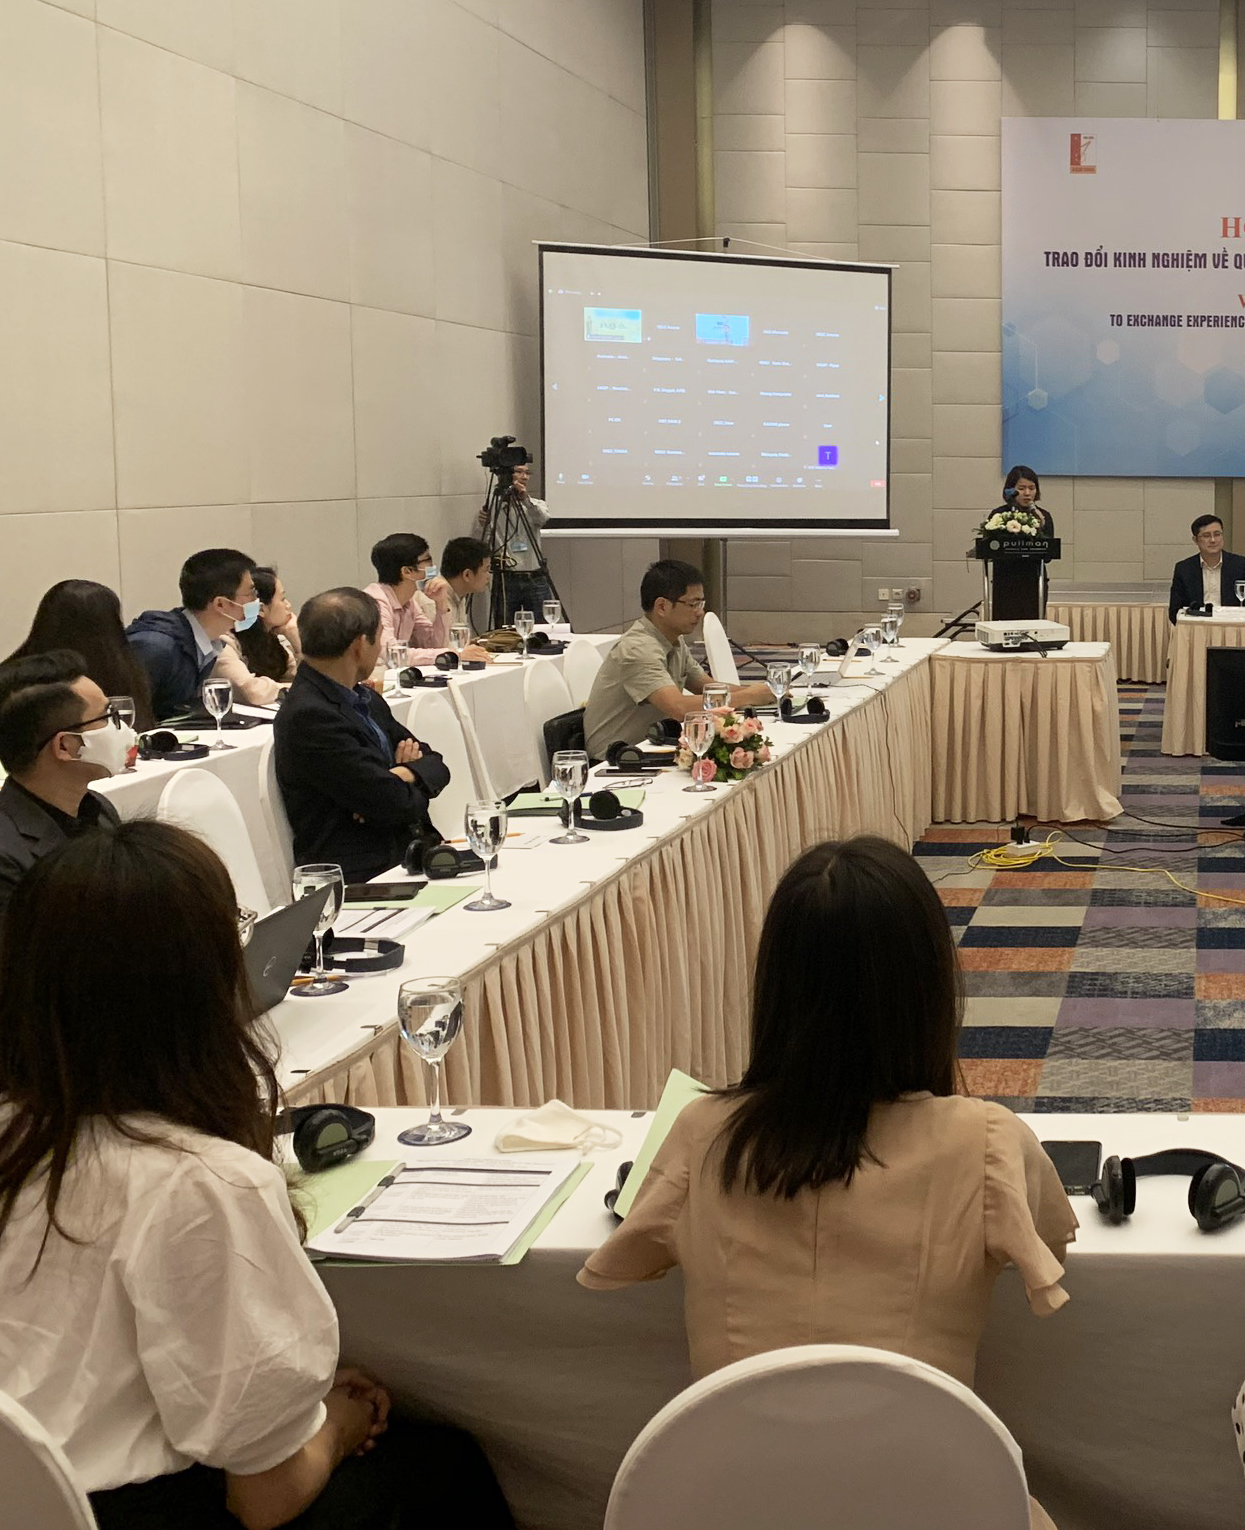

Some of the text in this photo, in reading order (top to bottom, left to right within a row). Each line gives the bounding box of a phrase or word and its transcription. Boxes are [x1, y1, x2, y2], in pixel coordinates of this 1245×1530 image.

[1044, 251, 1079, 268] TRAO
[1084, 245, 1108, 268] ĐỔI
[1113, 252, 1147, 268] KINH
[1151, 249, 1207, 272] NGHIỆM
[1212, 247, 1229, 270] VỀ
[1109, 314, 1123, 327] TO
[1127, 314, 1183, 328] EXCHANGE
[825, 451, 831, 461] T
